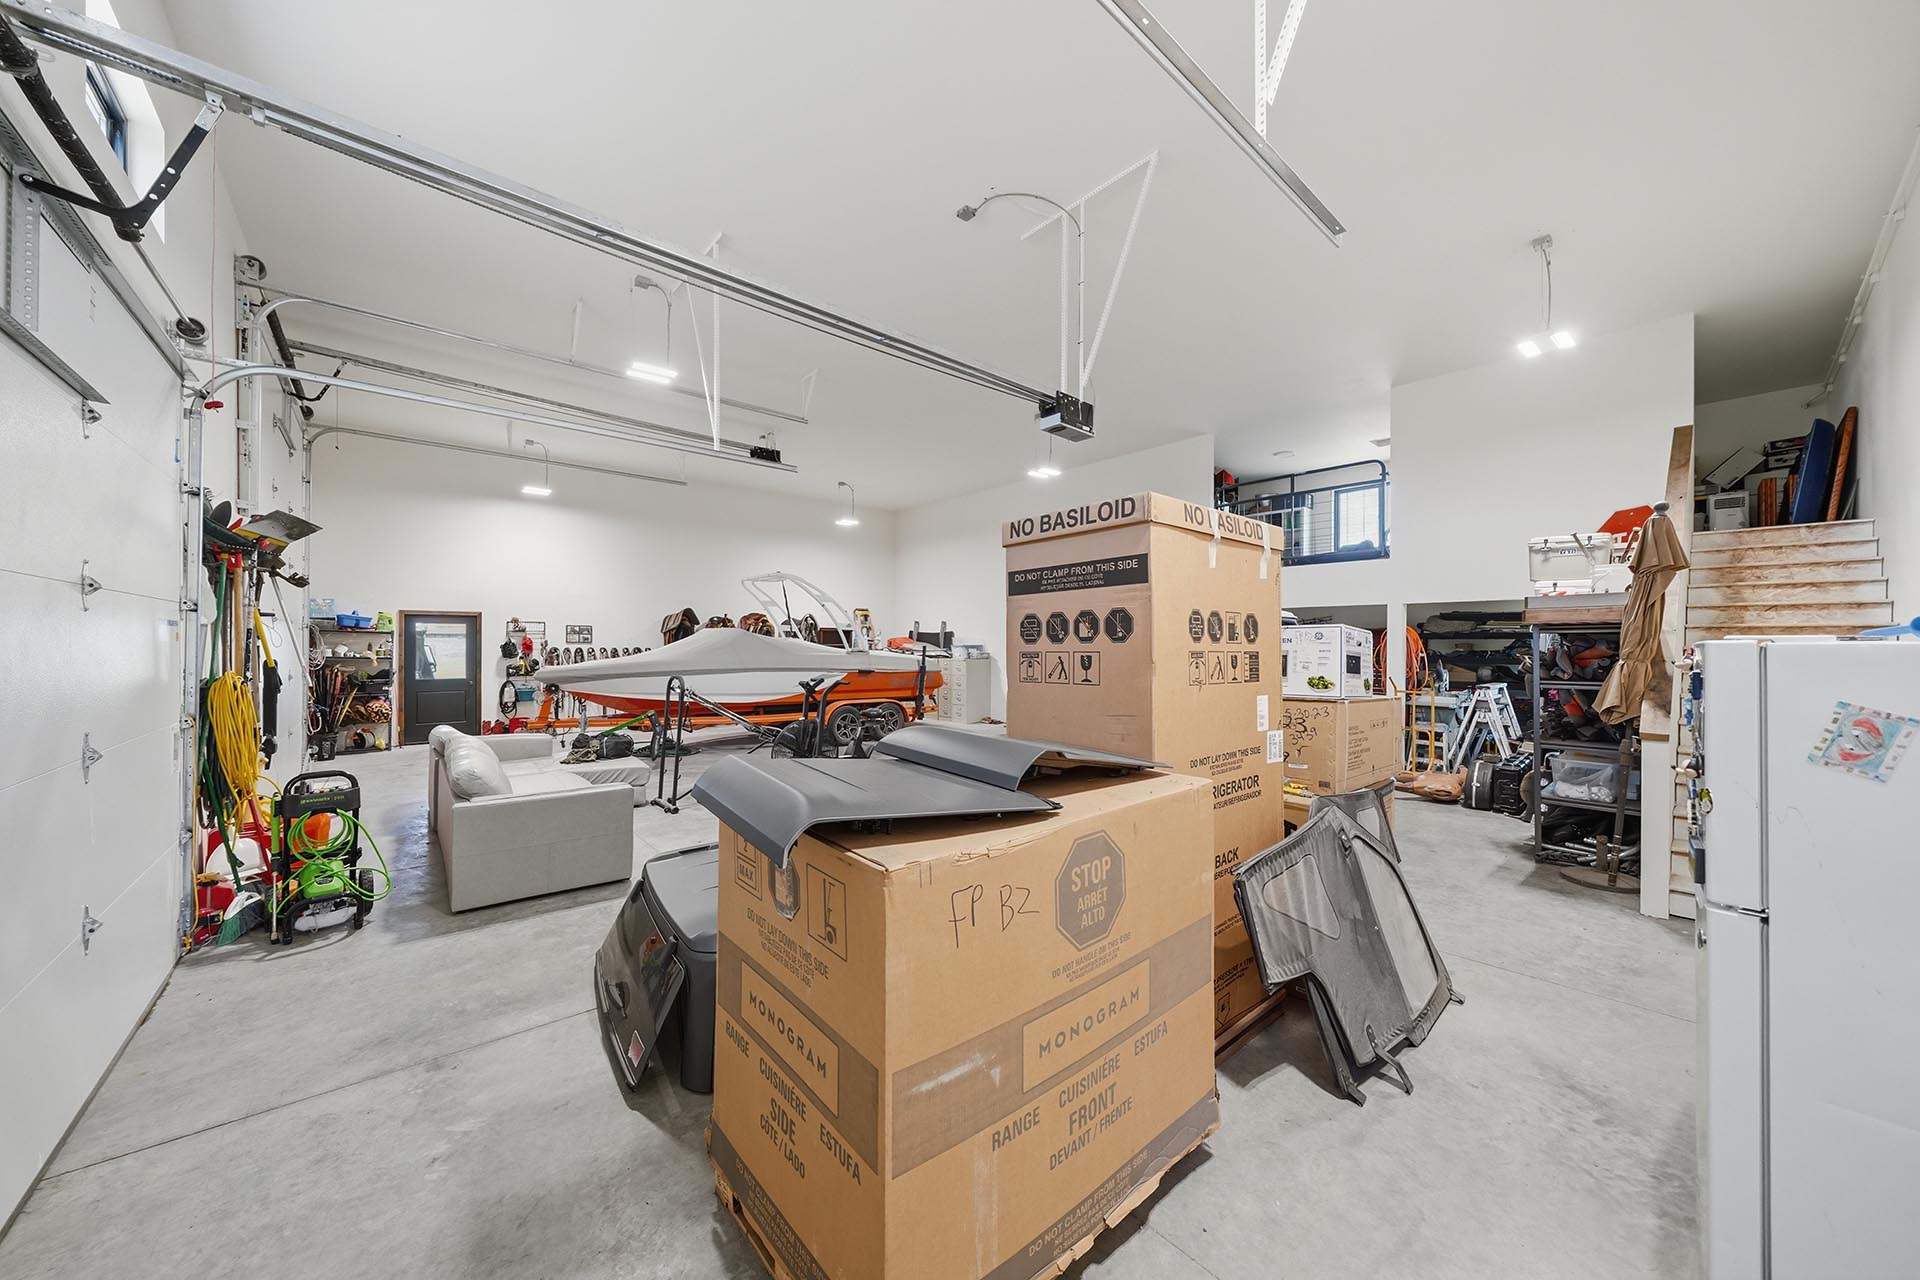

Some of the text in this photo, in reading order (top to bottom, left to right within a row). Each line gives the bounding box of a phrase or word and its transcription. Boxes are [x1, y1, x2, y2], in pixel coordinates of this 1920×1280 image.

[1010, 497, 1136, 539] NO BASILOID
[1184, 503, 1264, 540] NO ASILOID
[1014, 574, 1025, 582] DO
[1026, 571, 1041, 580] NOT
[1042, 568, 1068, 579] CLAMP
[1071, 565, 1094, 576] FROM
[1096, 562, 1115, 572] THIS
[1118, 558, 1138, 570] SIDE
[1190, 760, 1198, 768] DO
[1199, 756, 1210, 766] NOT
[1211, 754, 1222, 764] LAY
[1222, 750, 1238, 762] DOWN
[1238, 748, 1250, 758] THIS
[1250, 746, 1262, 756] SIDE
[1212, 774, 1260, 799] RIGERATOR
[1071, 856, 1112, 892] STOP
[1215, 846, 1240, 868] BACK
[1080, 906, 1106, 930] ALTO
[767, 922, 778, 938] LAY
[798, 944, 812, 966] THIS
[814, 957, 828, 980] SIDE
[1052, 968, 1061, 979] DO
[1062, 961, 1074, 974] NOT
[750, 992, 826, 1078] MONOGRAM
[1039, 987, 1140, 1058] MONOGRAM
[726, 1020, 750, 1058] RANGE
[820, 1123, 862, 1186] ESTUFA
[992, 1106, 1040, 1152] RANGE
[1134, 1020, 1168, 1057] ESTUFA
[770, 1097, 796, 1146] SIDE
[1068, 1082, 1118, 1136] FRONT
[1049, 1128, 1092, 1171] DEVANT
[1100, 1096, 1134, 1134] FRENTE
[784, 1142, 806, 1179] LADO
[1029, 1240, 1042, 1256] DO
[1044, 1223, 1062, 1244] NOT
[1064, 1199, 1092, 1226] CLAMP
[1094, 1178, 1114, 1203] FROM
[1116, 1164, 1132, 1184] THIS
[1132, 1150, 1148, 1169] SIDE
